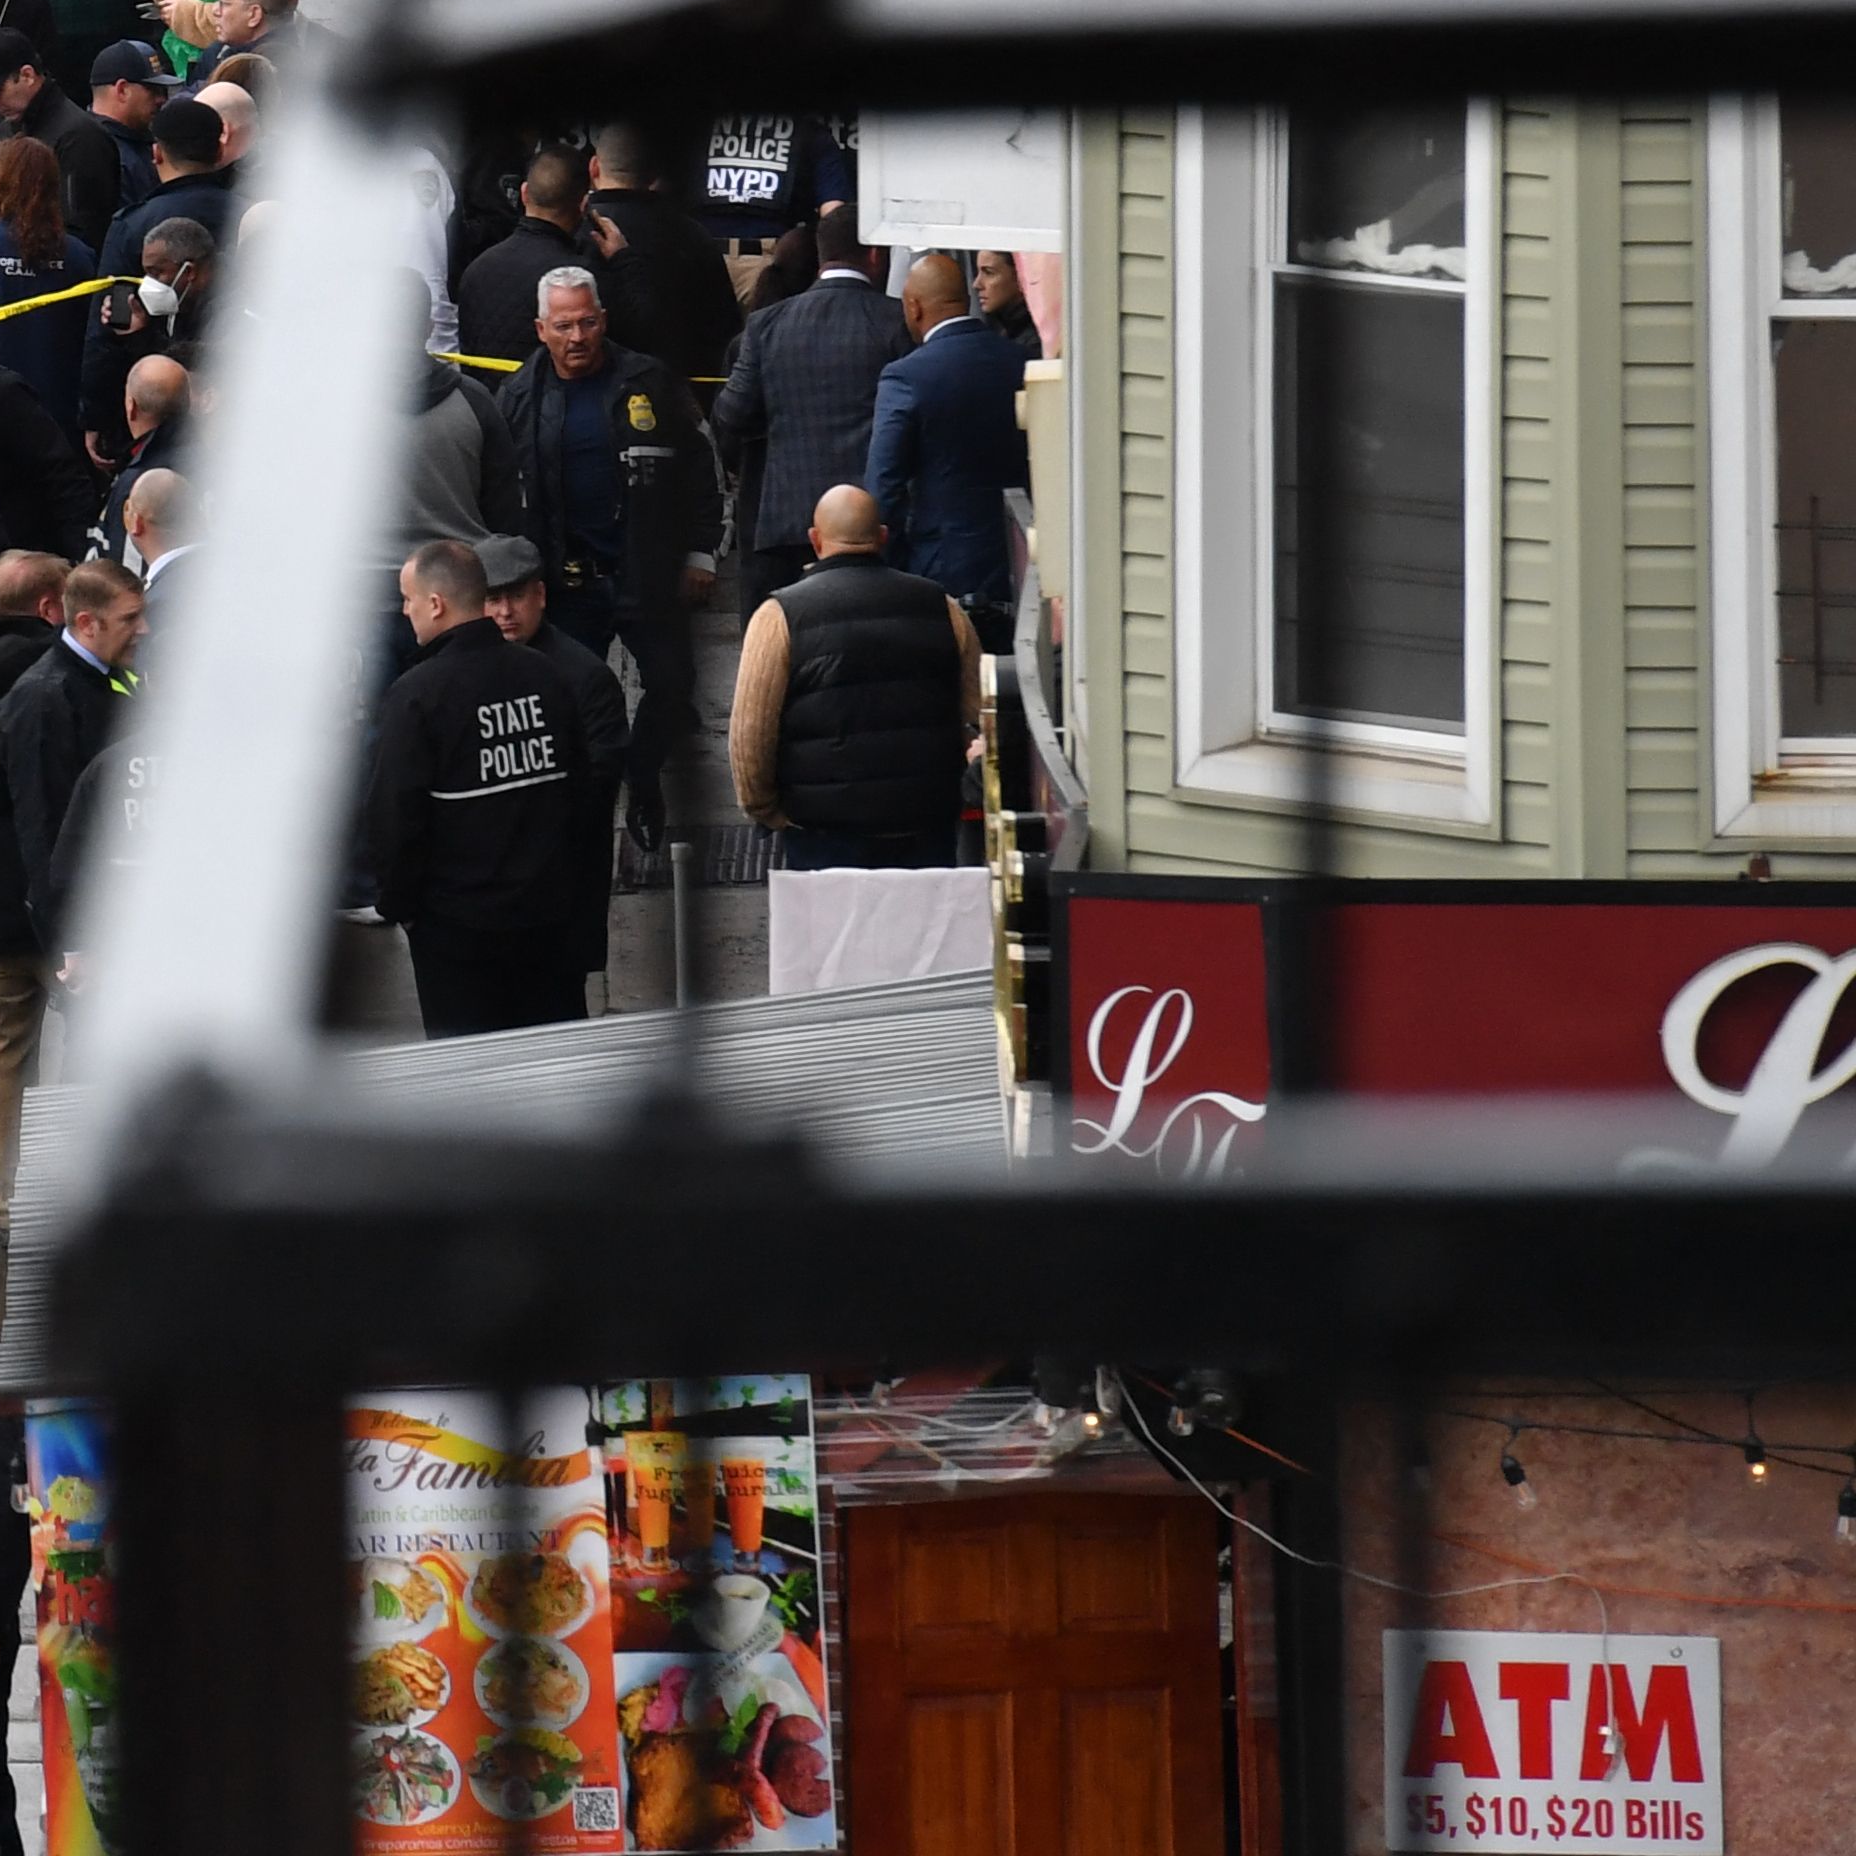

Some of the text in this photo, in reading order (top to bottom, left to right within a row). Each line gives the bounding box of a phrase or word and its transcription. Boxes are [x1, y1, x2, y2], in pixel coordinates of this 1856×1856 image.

[708, 135, 790, 163] POLICE
[706, 167, 780, 193] NYPD
[477, 694, 545, 740] STATE
[479, 734, 557, 782] POLICE
[410, 1504, 487, 1524] Caribbean
[1401, 1660, 1705, 1784] ATM
[1407, 1796, 1705, 1843] $5, $10, $20 Bills
